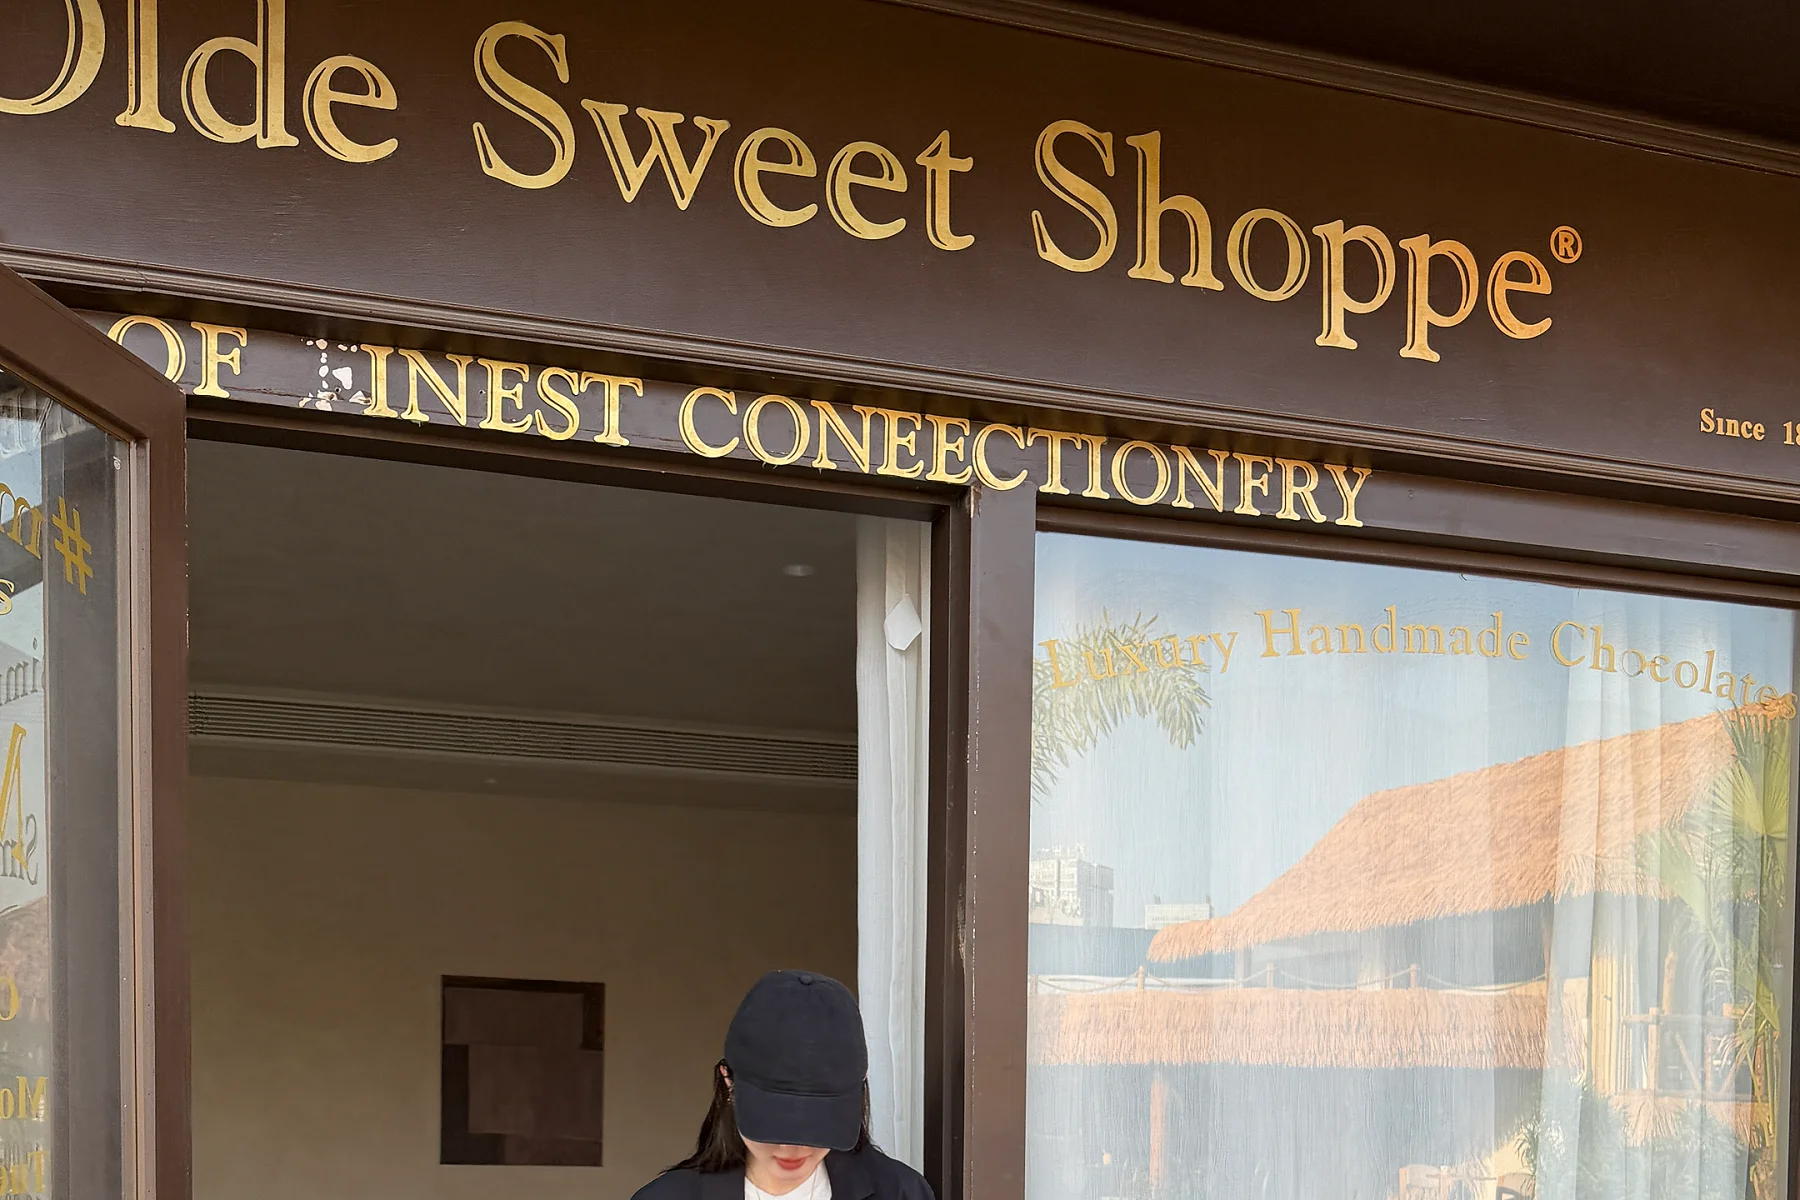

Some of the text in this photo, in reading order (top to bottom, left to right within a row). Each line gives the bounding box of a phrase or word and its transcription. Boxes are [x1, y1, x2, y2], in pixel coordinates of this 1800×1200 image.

[473, 20, 976, 251] Sweet
[106, 315, 248, 398] OF
[299, 338, 643, 447] INEST
[1700, 407, 1766, 441] Since
[1037, 604, 1799, 720] Luxury Handmade Chocolates
